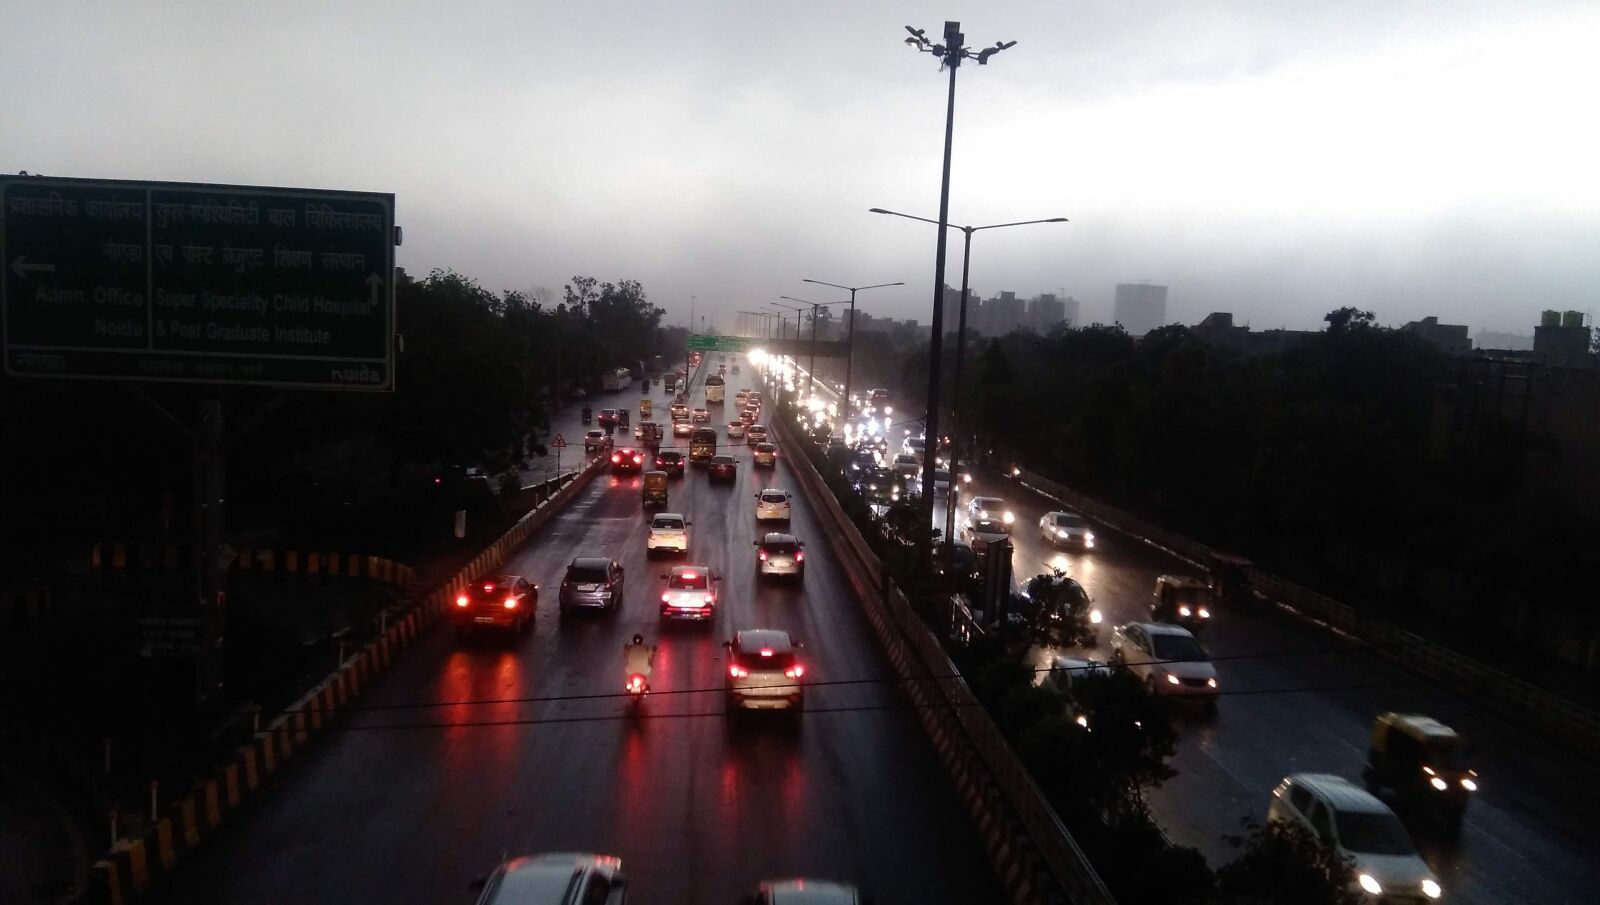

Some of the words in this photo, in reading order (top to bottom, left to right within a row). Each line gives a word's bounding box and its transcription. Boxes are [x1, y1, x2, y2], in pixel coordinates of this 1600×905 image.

[267, 208, 296, 228] बाल
[94, 286, 144, 306] Office
[155, 288, 196, 312] Super
[198, 289, 269, 315] Speciality
[273, 294, 309, 313] Child
[314, 296, 371, 317] Hospital
[94, 318, 143, 337] Noida
[155, 320, 166, 338] &
[170, 320, 201, 339] Post
[207, 322, 270, 342] Graduate
[275, 325, 331, 345] Institute
